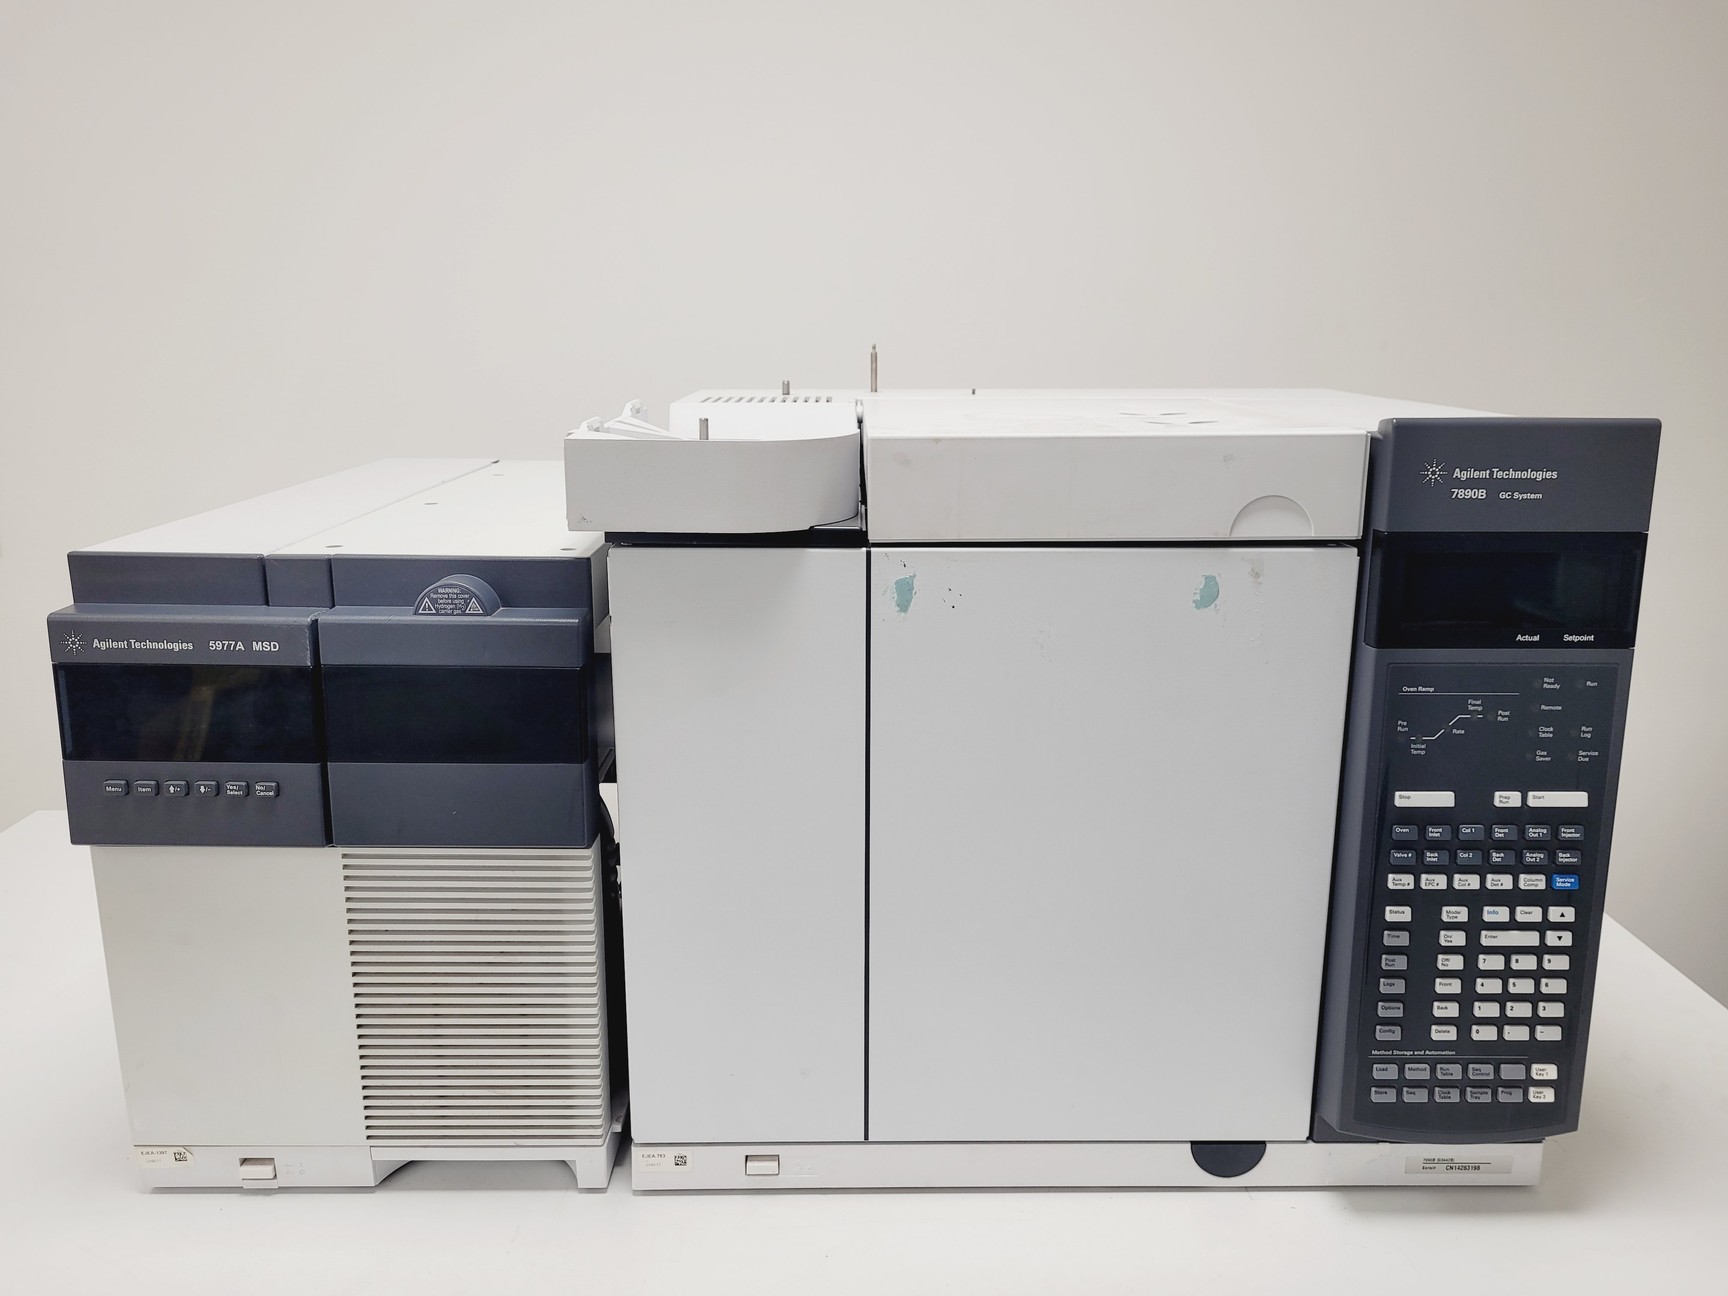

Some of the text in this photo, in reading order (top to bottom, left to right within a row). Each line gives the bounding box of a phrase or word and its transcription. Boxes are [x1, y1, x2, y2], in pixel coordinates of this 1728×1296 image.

[1453, 468, 1558, 480] Agilent Technologies
[1451, 489, 1487, 499] 7890B
[1513, 492, 1542, 500] System
[1563, 634, 1594, 643] Setpoint
[92, 639, 279, 651] Agilent Technologies 5977A MSD
